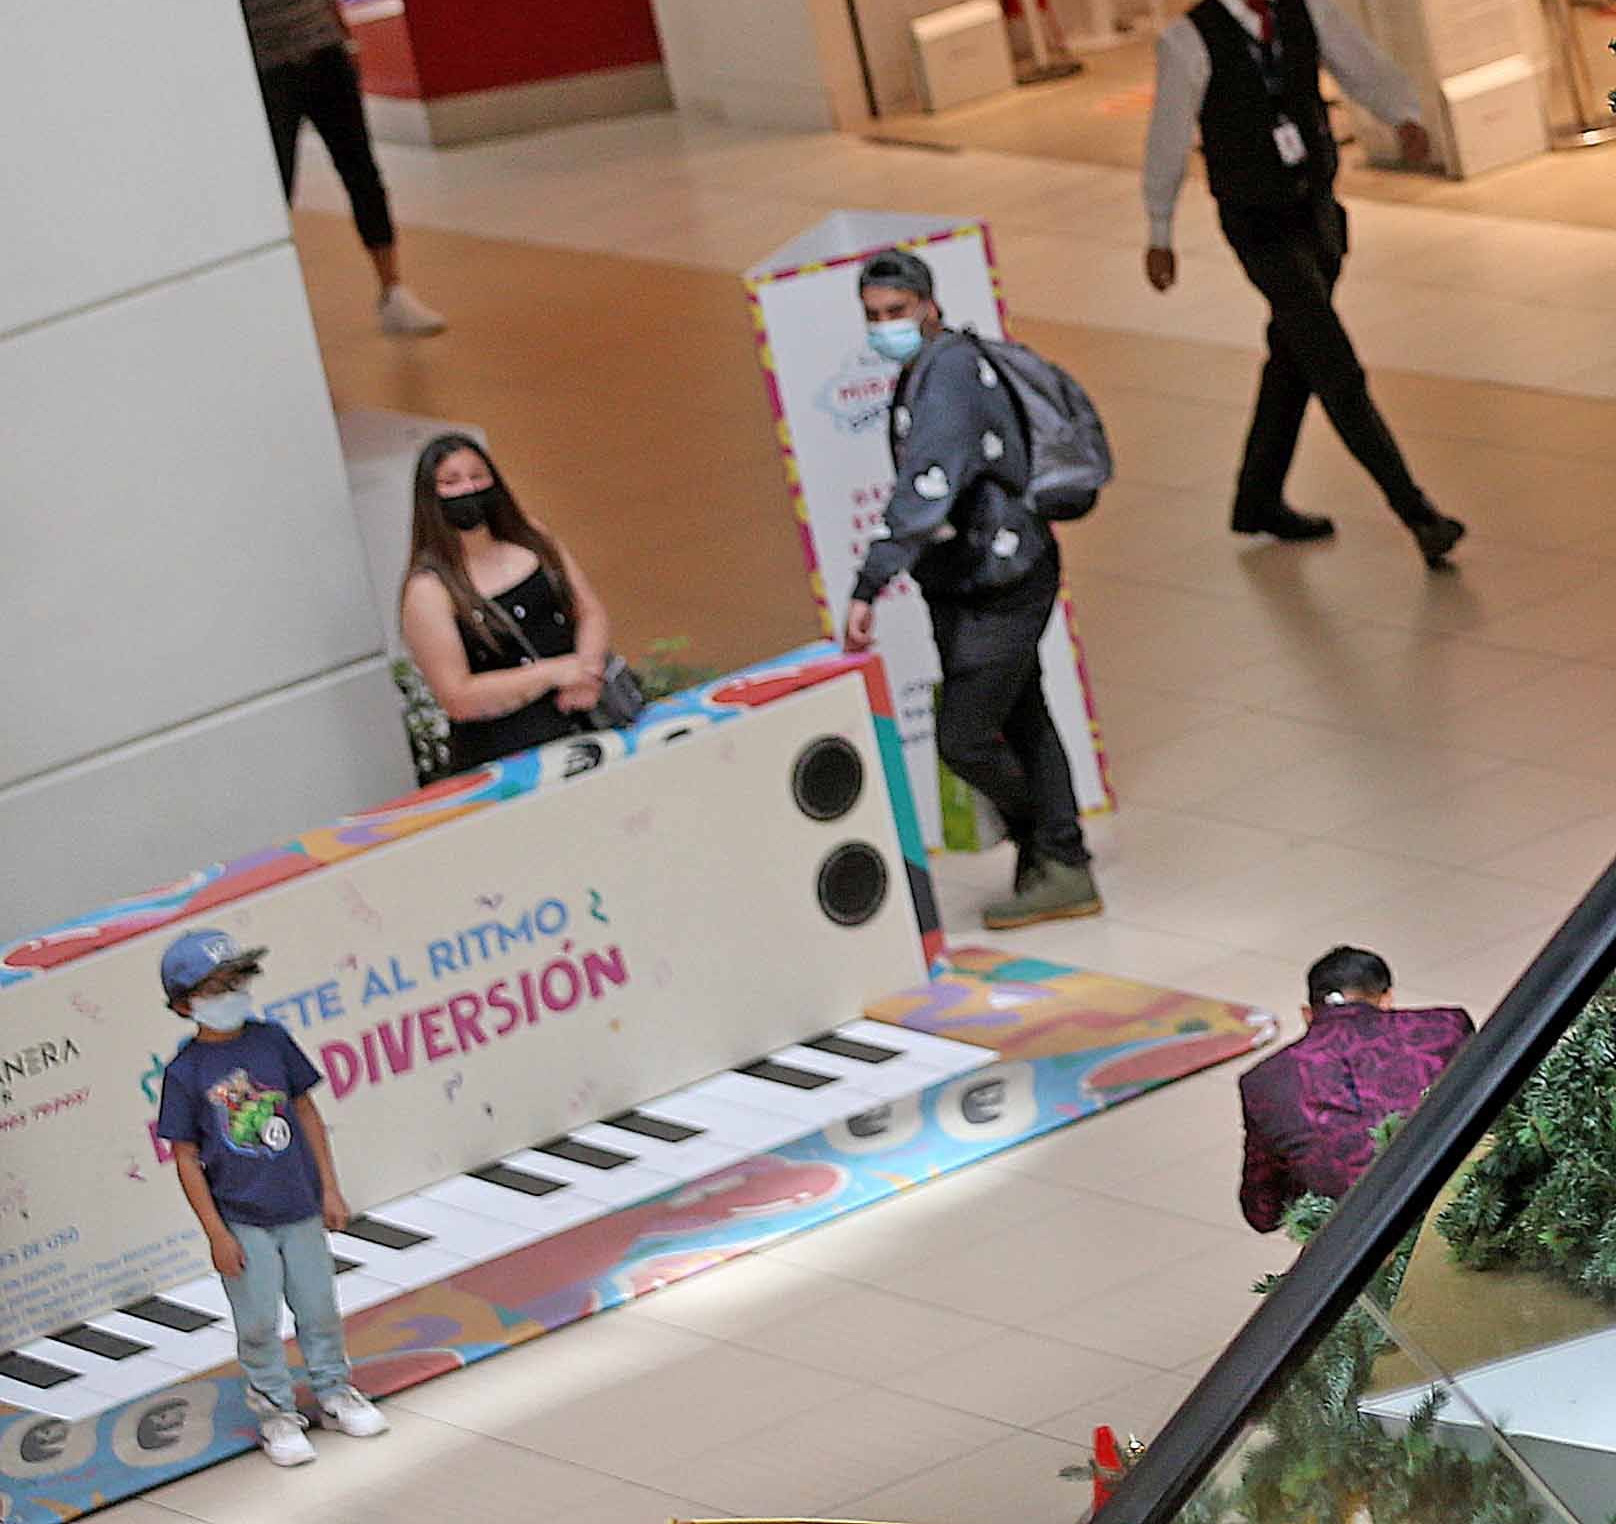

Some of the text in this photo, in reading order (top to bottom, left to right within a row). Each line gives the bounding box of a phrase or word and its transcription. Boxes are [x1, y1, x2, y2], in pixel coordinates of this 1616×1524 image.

[319, 938, 630, 1101] DIVERSIÓN
[361, 954, 418, 1007] AL
[427, 896, 571, 978] RITMO
